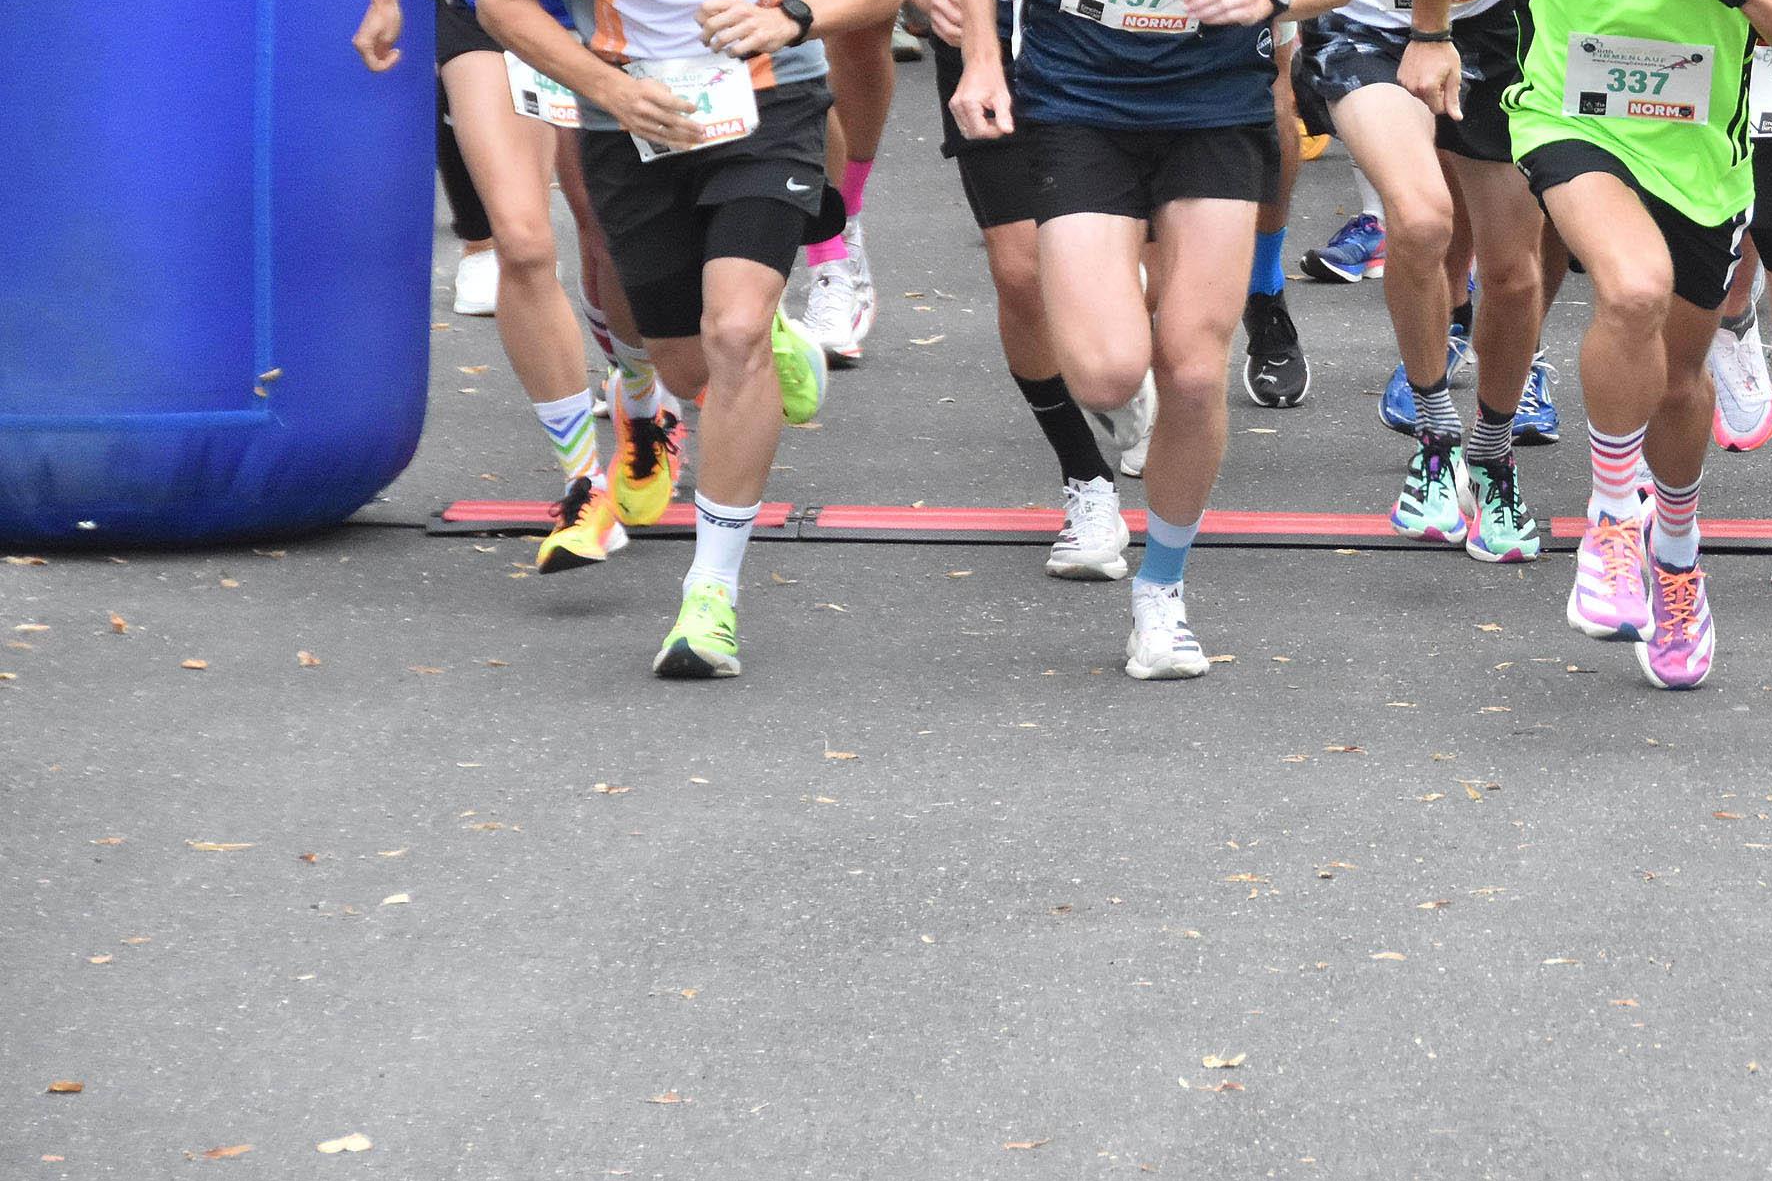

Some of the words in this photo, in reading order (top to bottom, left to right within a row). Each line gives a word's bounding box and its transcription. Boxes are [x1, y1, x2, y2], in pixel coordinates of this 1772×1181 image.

[1125, 15, 1184, 29] NORMA
[1606, 68, 1670, 95] 337
[1630, 103, 1692, 118] NORM
